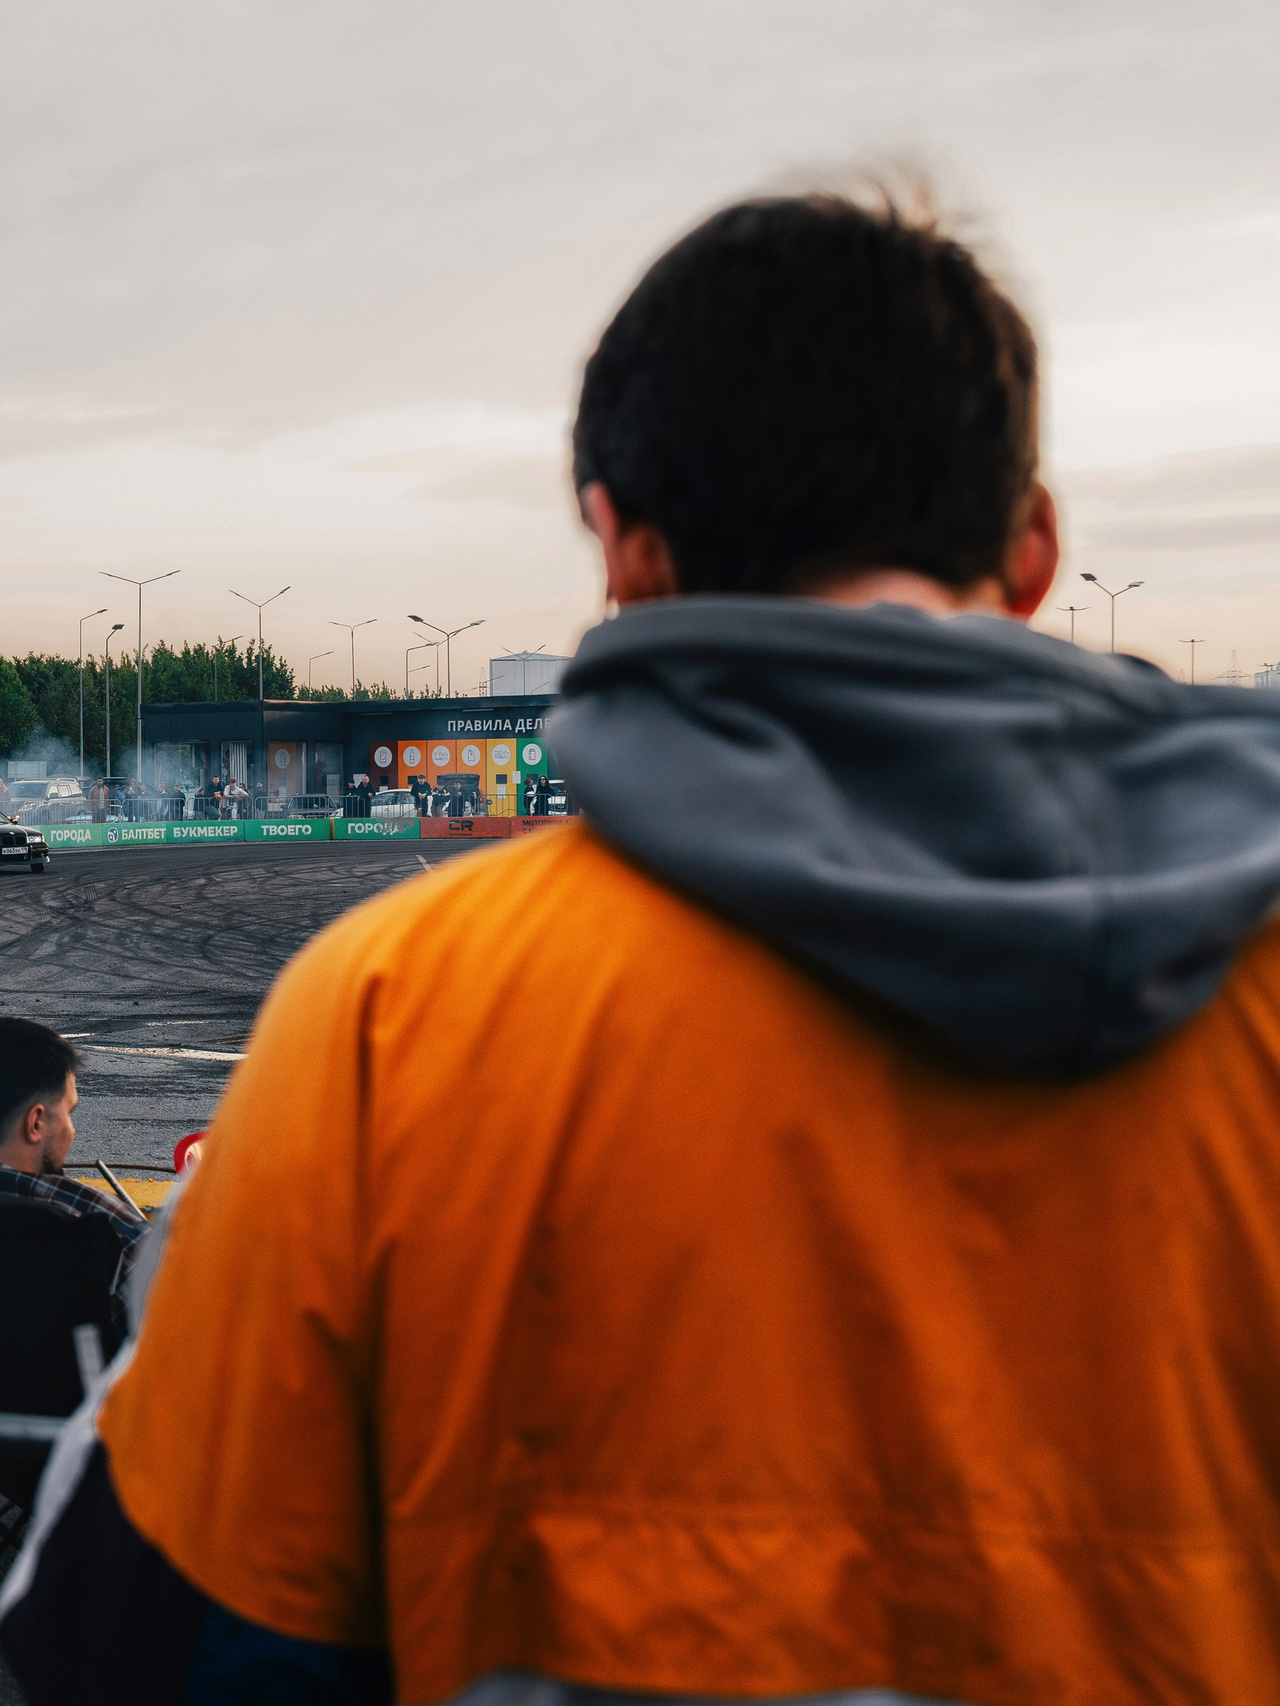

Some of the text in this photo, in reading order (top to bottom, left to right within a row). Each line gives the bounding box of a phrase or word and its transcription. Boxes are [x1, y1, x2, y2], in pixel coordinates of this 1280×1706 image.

[447, 719, 513, 732] ПРАВИЛА
[50, 829, 92, 842] ГОРОДА
[121, 828, 167, 840] БАЛТБЕТ
[173, 825, 239, 838] БУКМЕКЕР
[261, 824, 312, 836] ТВОЕГО
